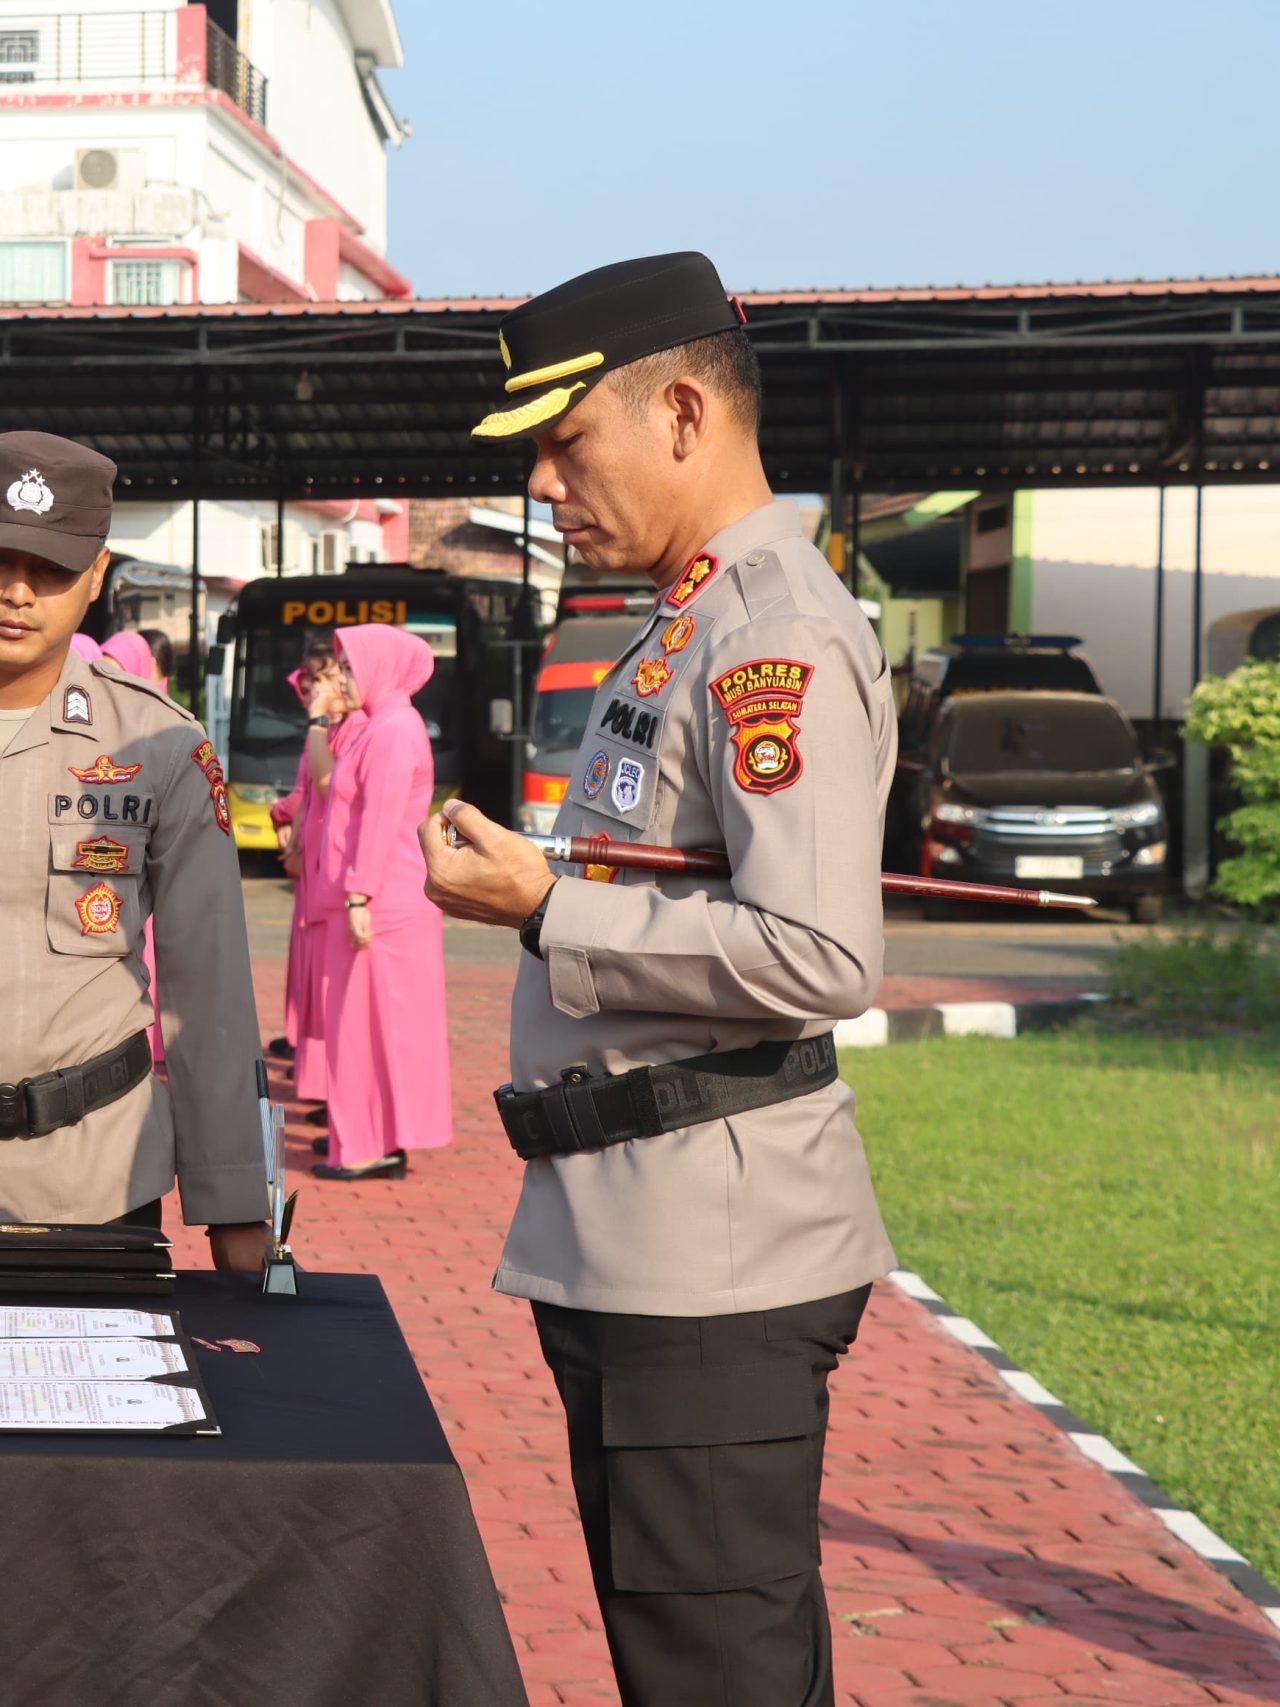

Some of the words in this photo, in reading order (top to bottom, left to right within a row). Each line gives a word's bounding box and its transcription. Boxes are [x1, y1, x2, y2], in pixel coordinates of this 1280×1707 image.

[283, 601, 406, 626] POLISI
[721, 664, 801, 691] POLRES
[724, 684, 745, 702] MUSI
[746, 677, 802, 691] BANYUASIN
[732, 702, 767, 720] SUMATERA
[768, 701, 797, 711] SELATAN
[601, 699, 658, 749] POLRI
[55, 794, 152, 823] POLRI
